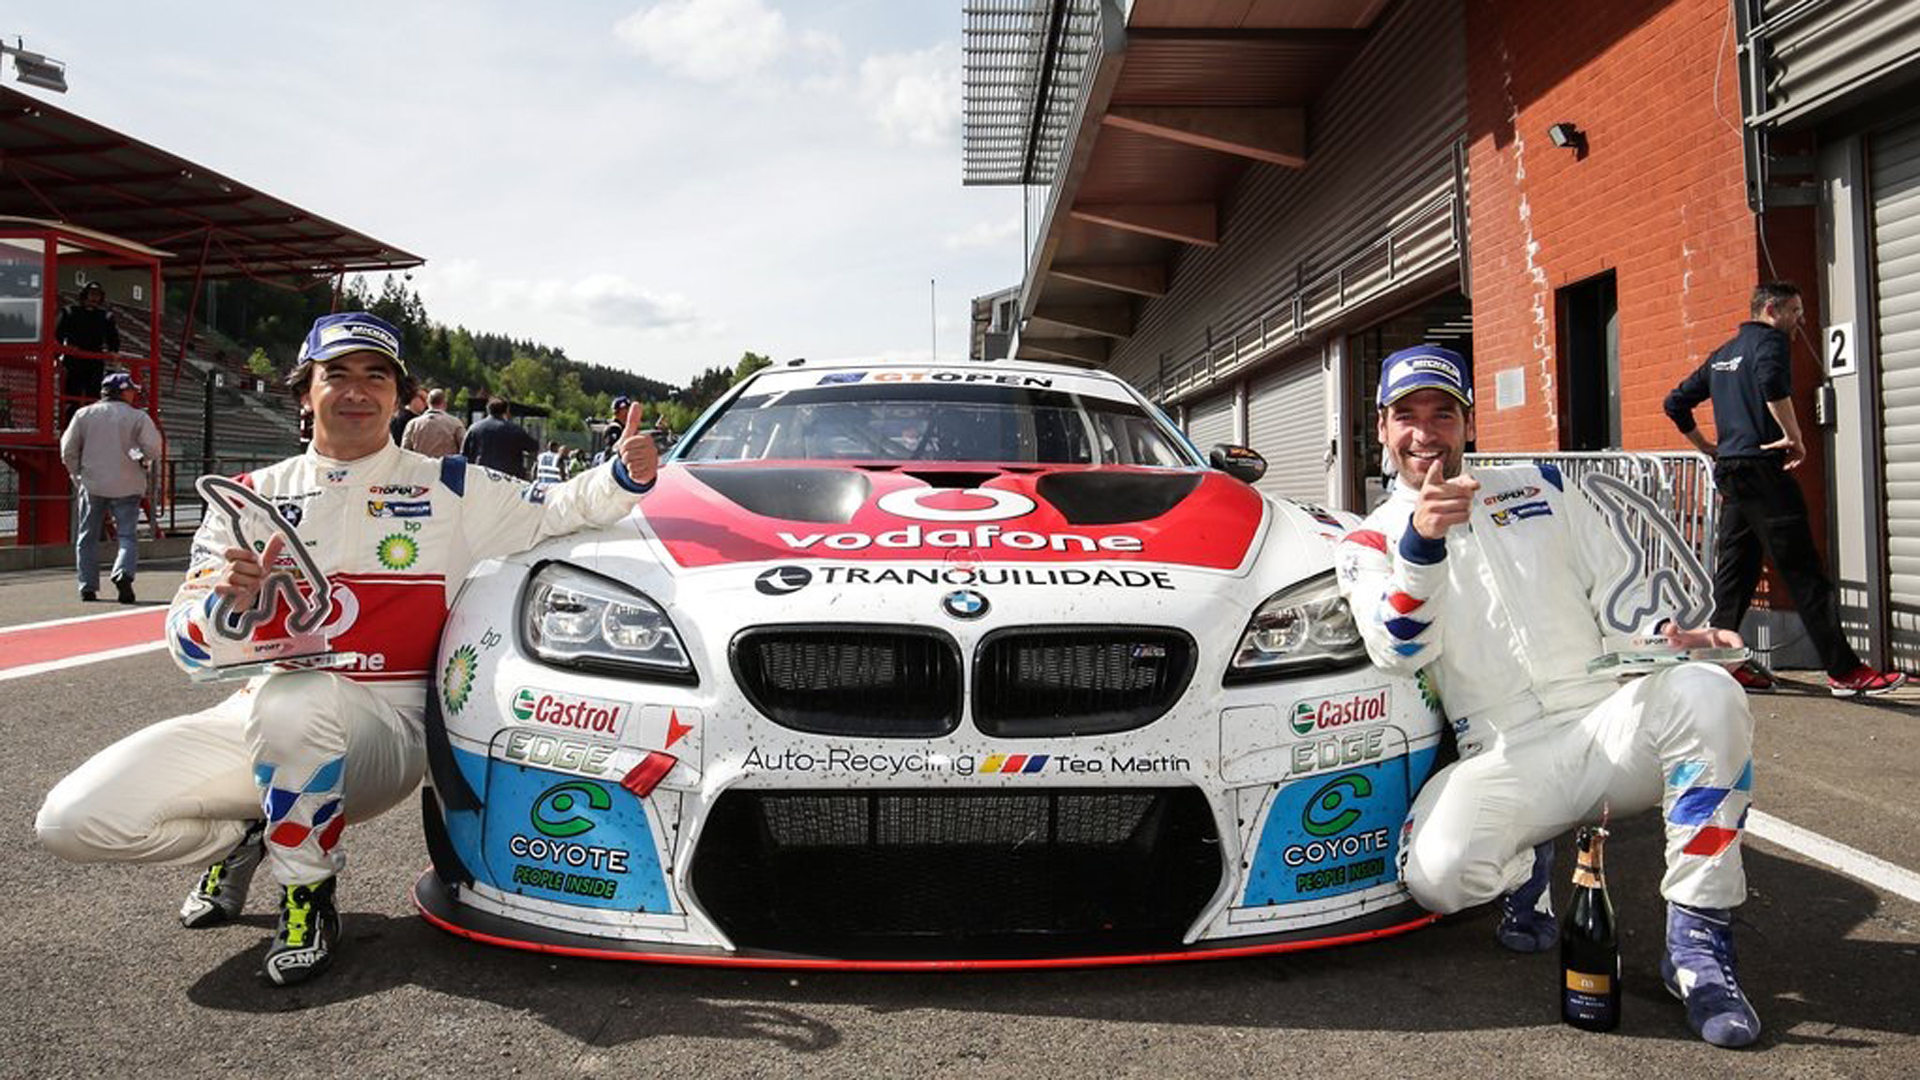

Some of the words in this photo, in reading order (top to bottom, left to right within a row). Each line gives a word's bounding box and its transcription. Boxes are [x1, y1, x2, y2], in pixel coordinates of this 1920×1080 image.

[1831, 329, 1846, 368] 2
[1412, 360, 1460, 378] MICHELIN
[404, 520, 422, 533] bp
[776, 525, 1143, 552] vodafone
[819, 566, 1177, 591] TRANQUILIDADE
[481, 626, 502, 650] bp
[535, 695, 620, 733] Castrol
[1317, 692, 1387, 729] Castrol
[505, 730, 617, 774] EDGE
[1054, 755, 1102, 772] Teo
[1292, 728, 1385, 774] EDGE
[510, 834, 630, 874] COYOTE
[1283, 828, 1390, 867] COYOTE
[513, 864, 565, 890] PEOPLE
[563, 874, 618, 899] INSIDE
[1296, 865, 1346, 892] PEOPLE
